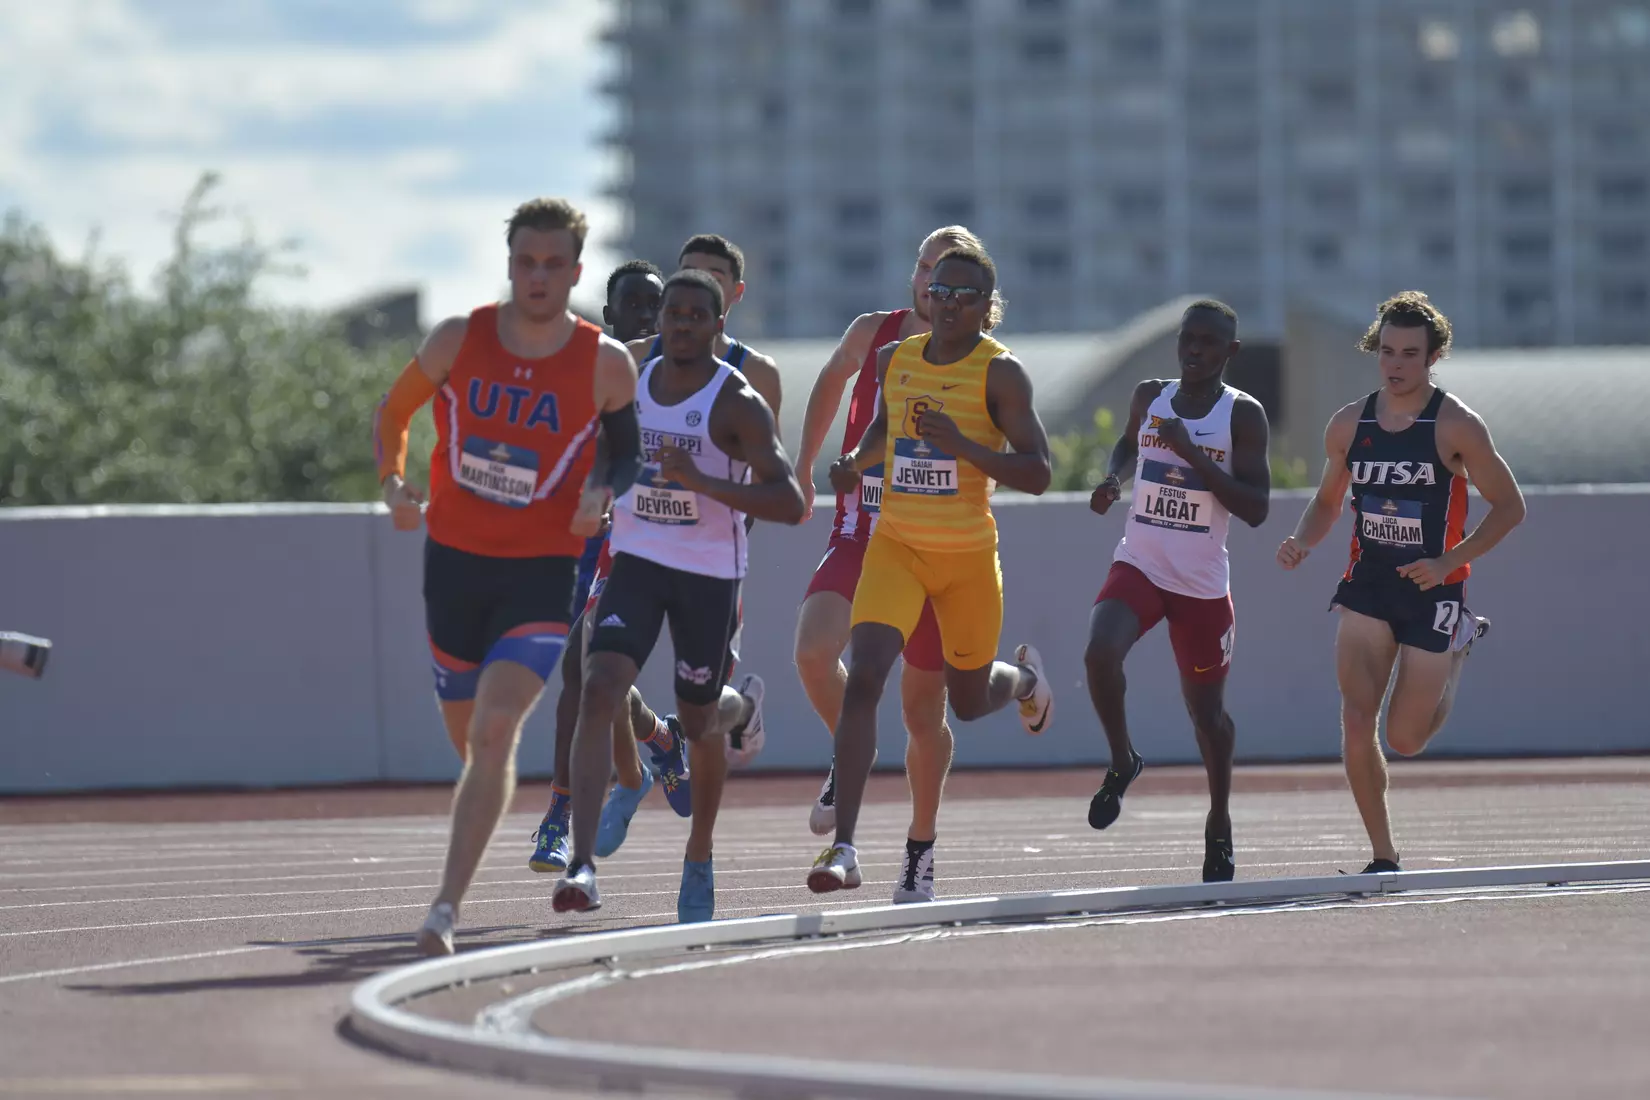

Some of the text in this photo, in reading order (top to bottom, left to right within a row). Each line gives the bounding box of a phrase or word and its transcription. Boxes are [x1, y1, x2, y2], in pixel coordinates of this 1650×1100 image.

[467, 377, 561, 434] UTA
[911, 460, 932, 469] ISAIAH
[1352, 461, 1436, 485] UTSA
[461, 464, 533, 498] MARTINSSON
[896, 467, 952, 486] JEWETT
[1160, 486, 1187, 500] FESTUS
[637, 494, 693, 517] DEVROE
[1145, 494, 1200, 522] LAGAT
[1364, 520, 1421, 542] CHATHAM
[1382, 516, 1398, 525] LUCA
[1438, 602, 1454, 632] 2
